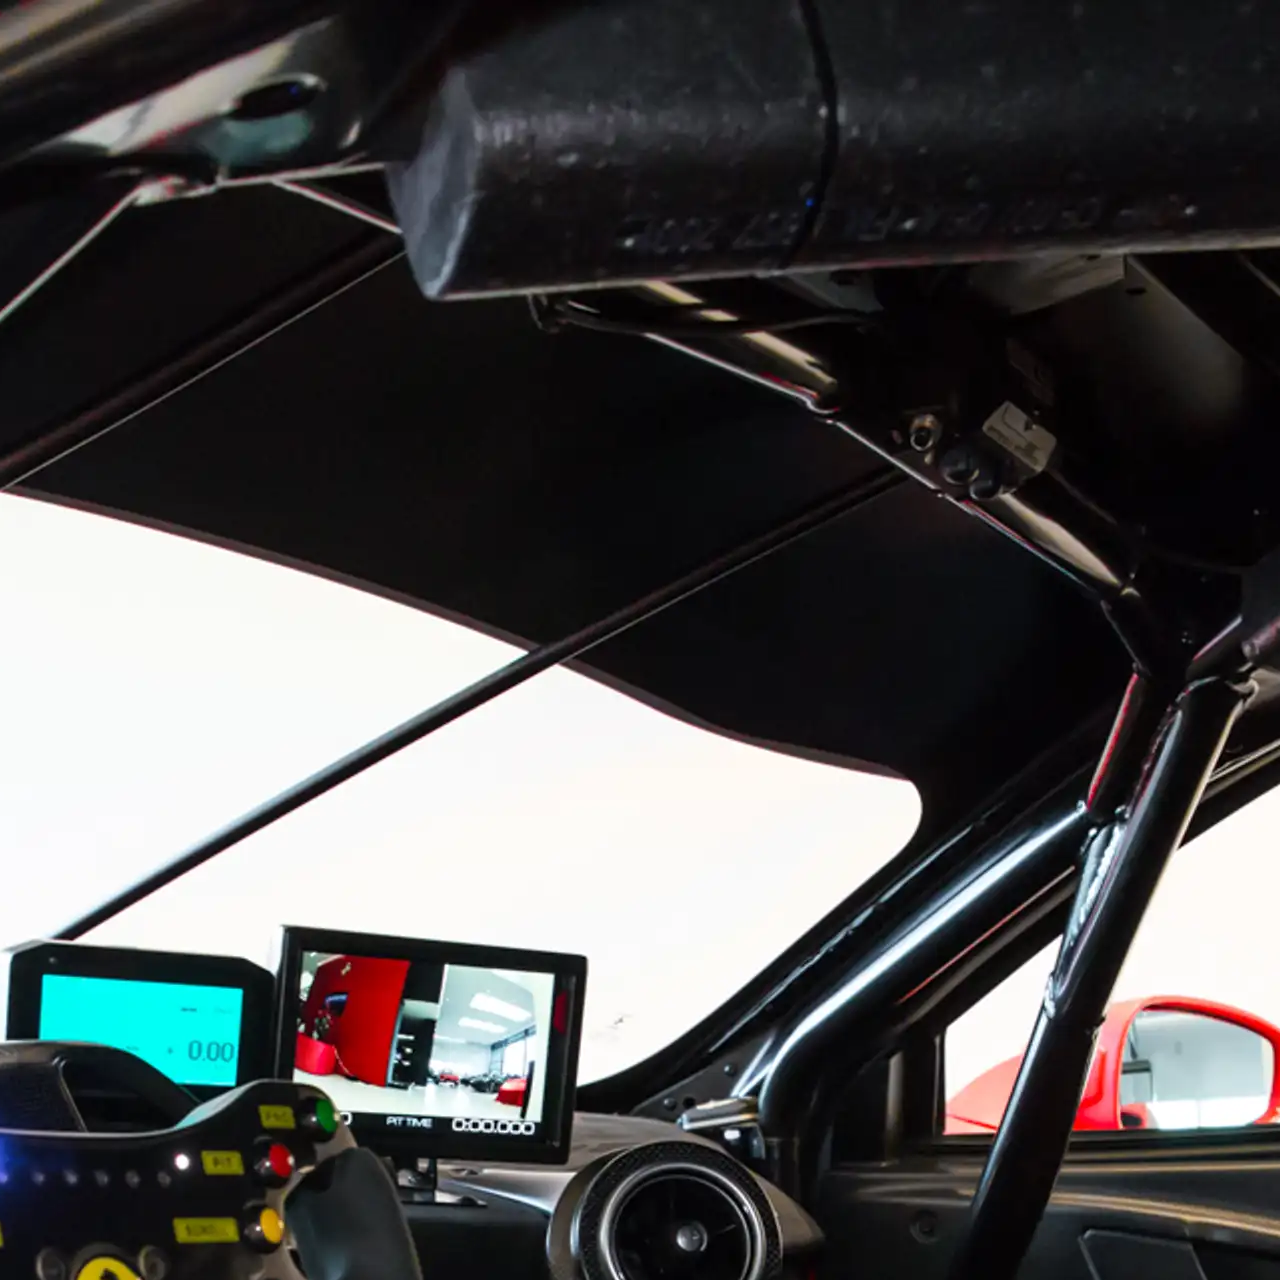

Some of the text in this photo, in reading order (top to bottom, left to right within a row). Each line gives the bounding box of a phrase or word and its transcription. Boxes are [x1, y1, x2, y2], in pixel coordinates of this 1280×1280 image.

[188, 1040, 235, 1063] 0.00
[386, 1115, 433, 1128] PIT TIME
[452, 1117, 535, 1136] 0:00.000
